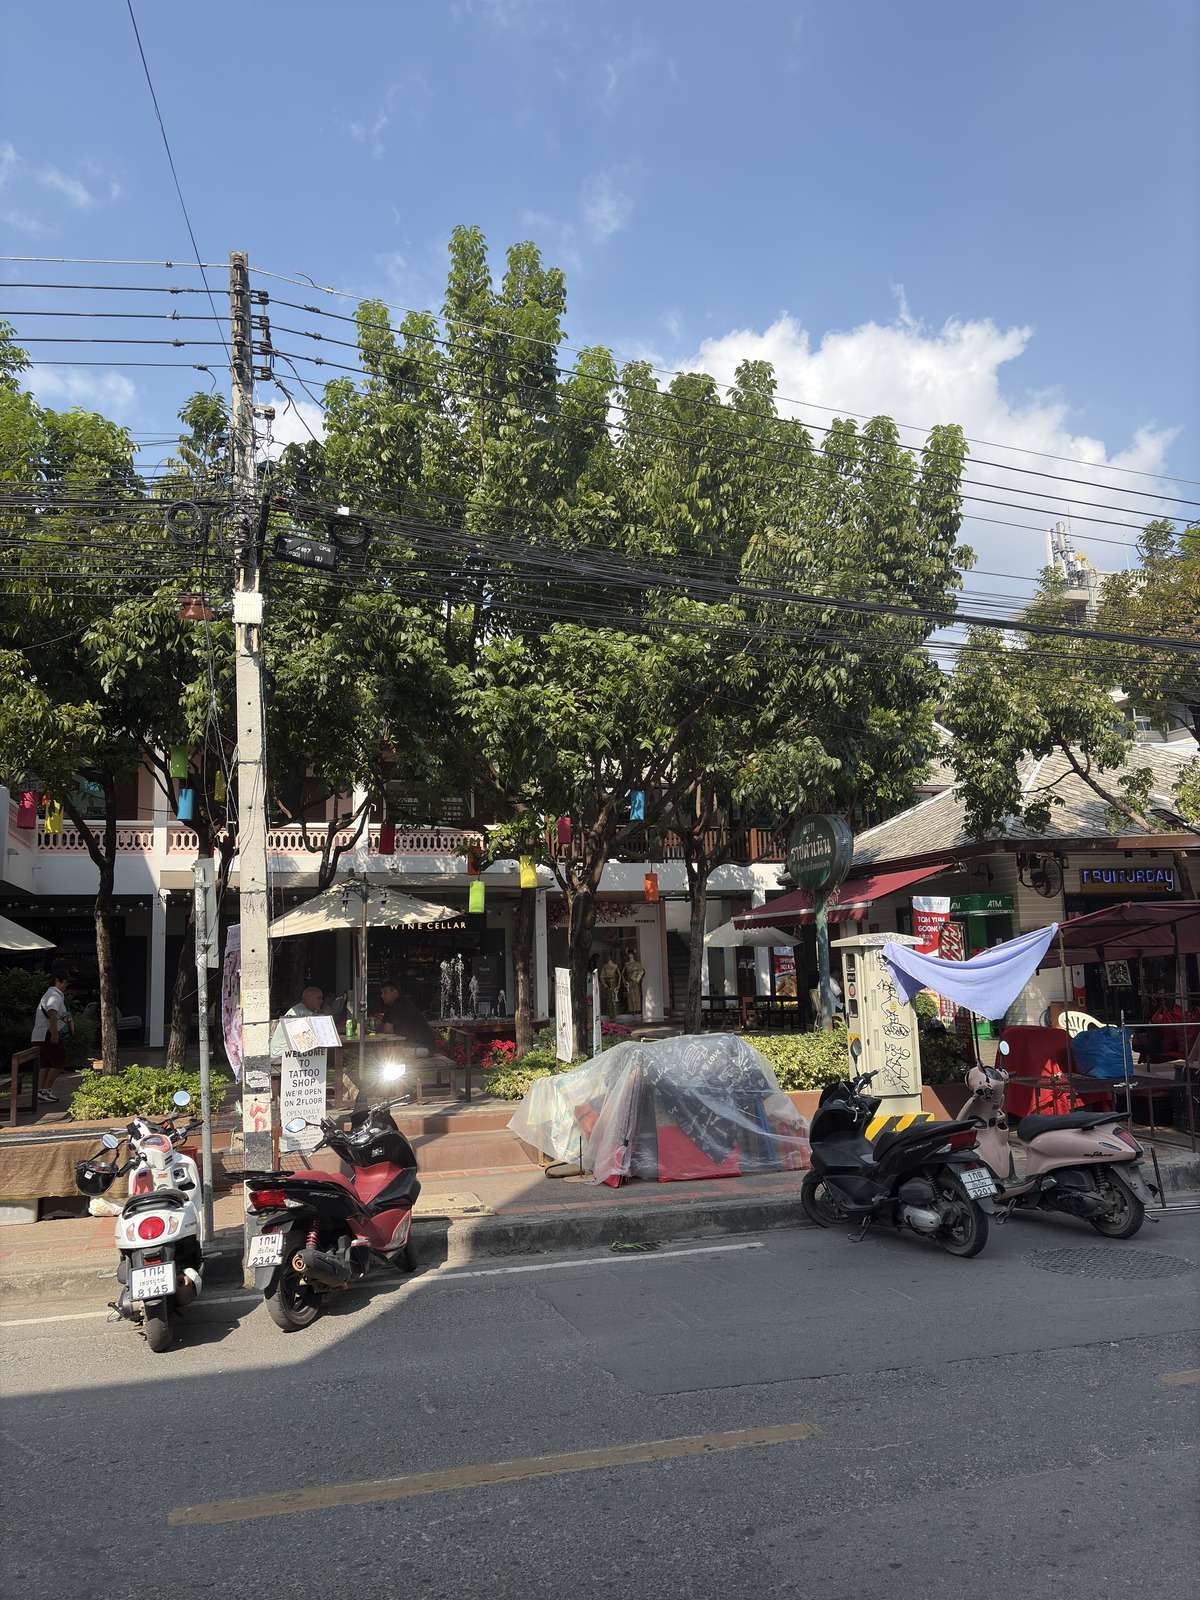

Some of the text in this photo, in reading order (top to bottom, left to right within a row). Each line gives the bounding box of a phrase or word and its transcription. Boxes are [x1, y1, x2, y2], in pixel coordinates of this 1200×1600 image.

[987, 900, 1002, 908] ATM
[389, 921, 467, 930] WINE CELLAR
[284, 1048, 326, 1058] WELCOME
[299, 1059, 310, 1068] TO
[288, 1068, 320, 1079] TATTOO
[292, 1078, 316, 1088] SHOP
[285, 1087, 322, 1097] WE'R OPEN
[284, 1099, 294, 1107] ON
[286, 1108, 302, 1117] OPEN
[302, 1107, 321, 1116] DAILY
[972, 1187, 993, 1197] 3201
[252, 1254, 276, 1265] 2347
[137, 1284, 169, 1298] 8145
